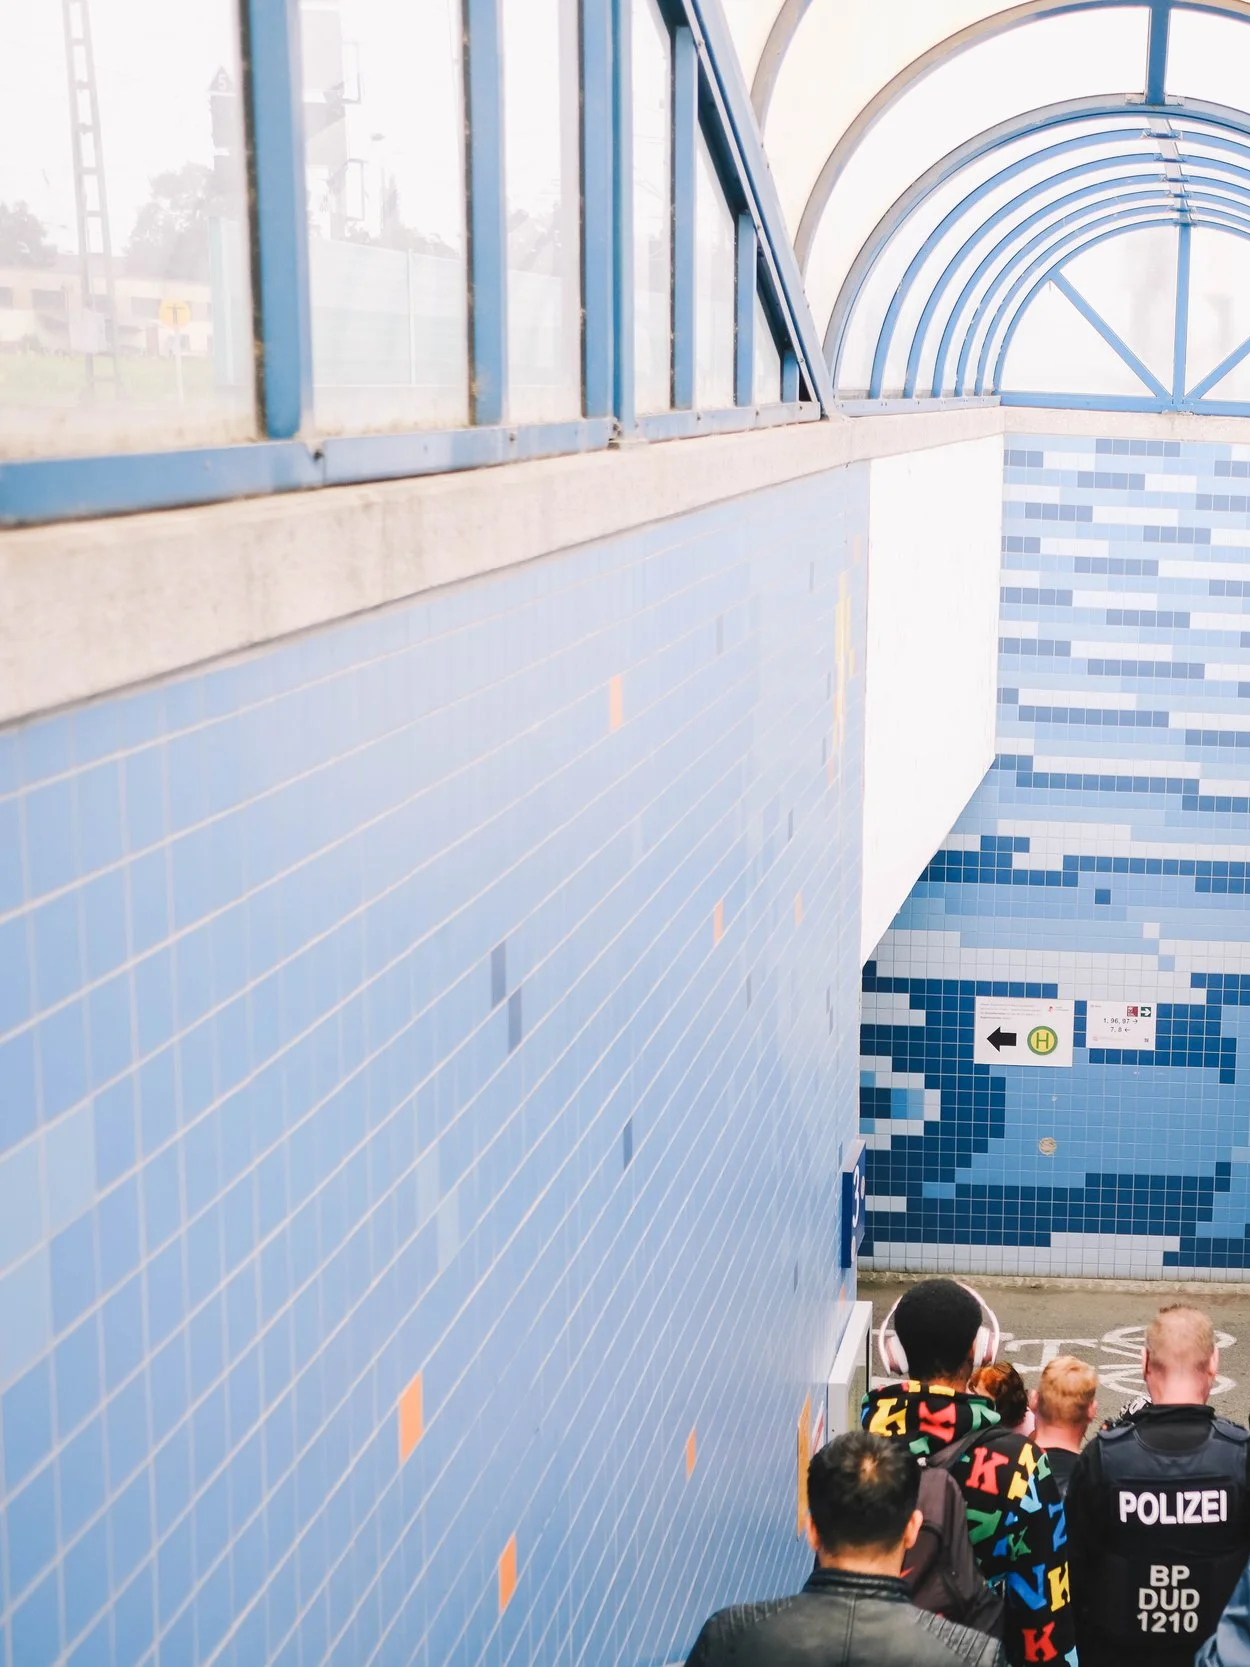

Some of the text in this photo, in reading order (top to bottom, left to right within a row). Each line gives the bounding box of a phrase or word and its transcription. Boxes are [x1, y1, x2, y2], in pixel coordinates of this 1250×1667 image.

[1036, 1032, 1049, 1049] H
[869, 1397, 908, 1437] K
[965, 1446, 1010, 1496] K
[1119, 1489, 1228, 1525] POLIZEI
[1047, 1561, 1071, 1612] K
[1149, 1565, 1191, 1587] BP
[1138, 1587, 1201, 1611] DUD
[1136, 1610, 1199, 1634] 1210
[1022, 1621, 1058, 1662] K
